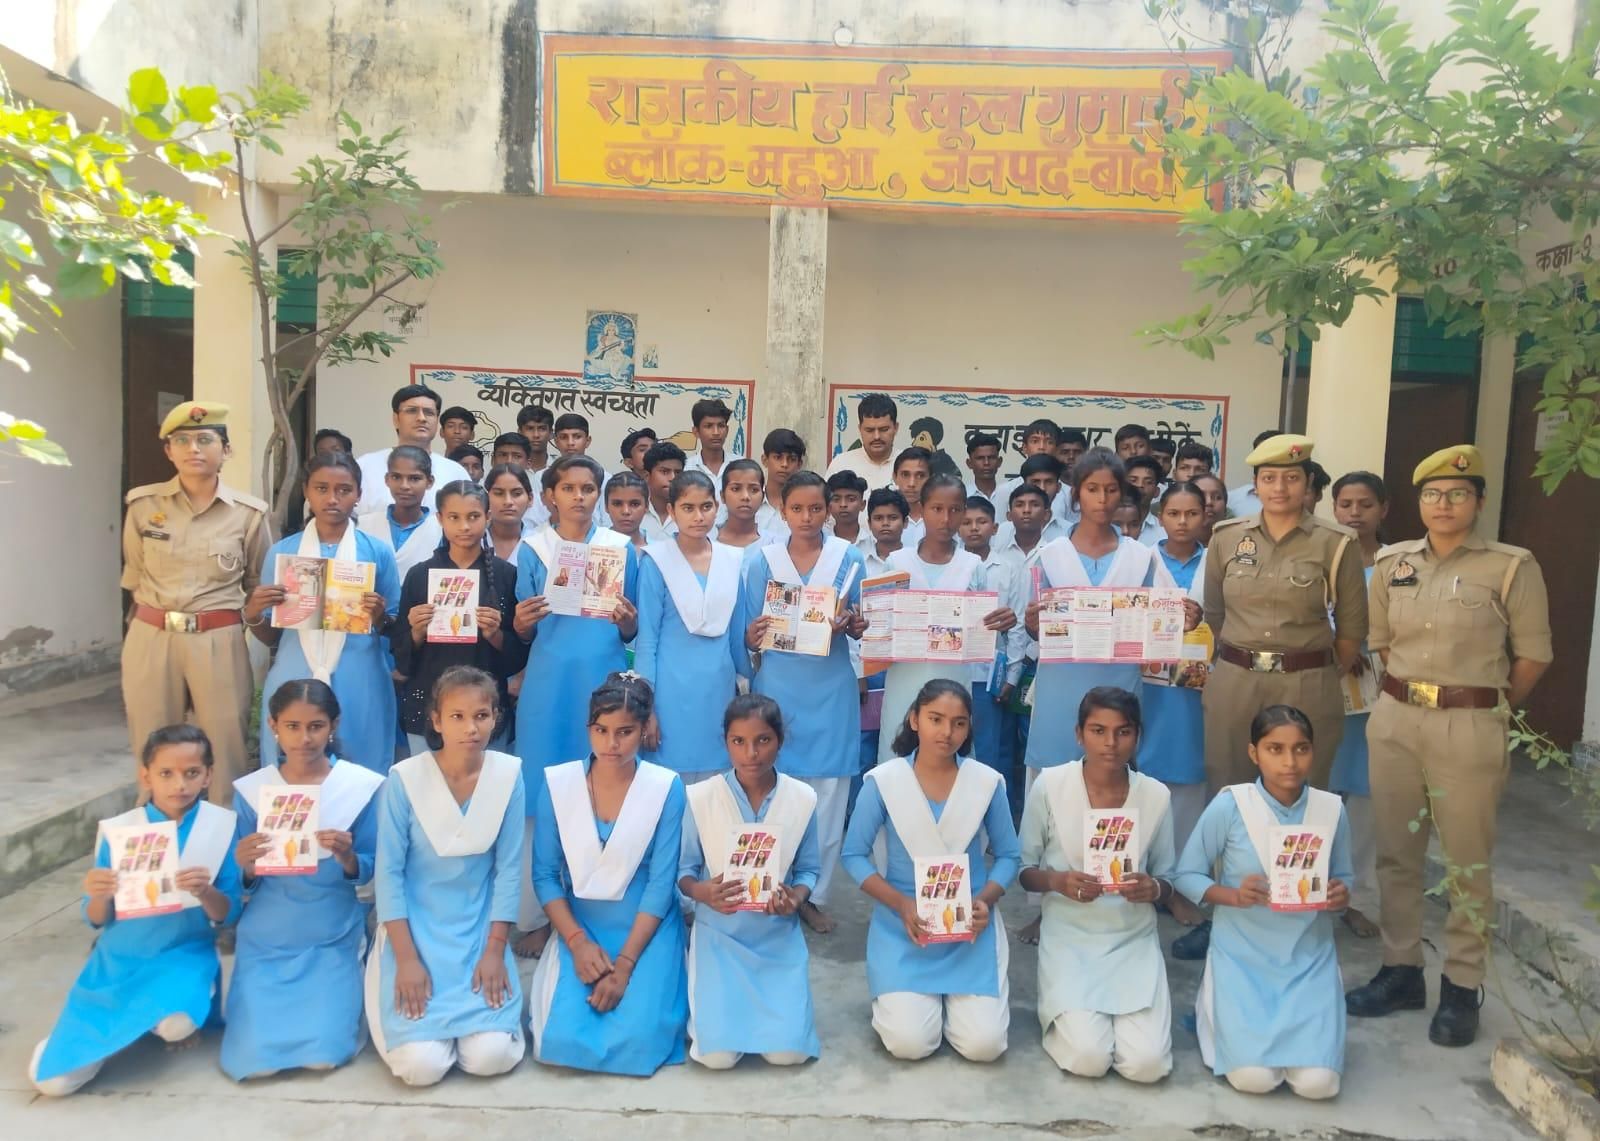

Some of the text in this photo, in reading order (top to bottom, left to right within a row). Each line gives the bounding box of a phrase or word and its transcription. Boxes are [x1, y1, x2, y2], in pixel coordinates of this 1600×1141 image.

[587, 60, 799, 131] राजकीय
[811, 63, 910, 144] हाई
[904, 84, 1030, 150] स्कूल
[580, 389, 660, 419] स्वच्छता
